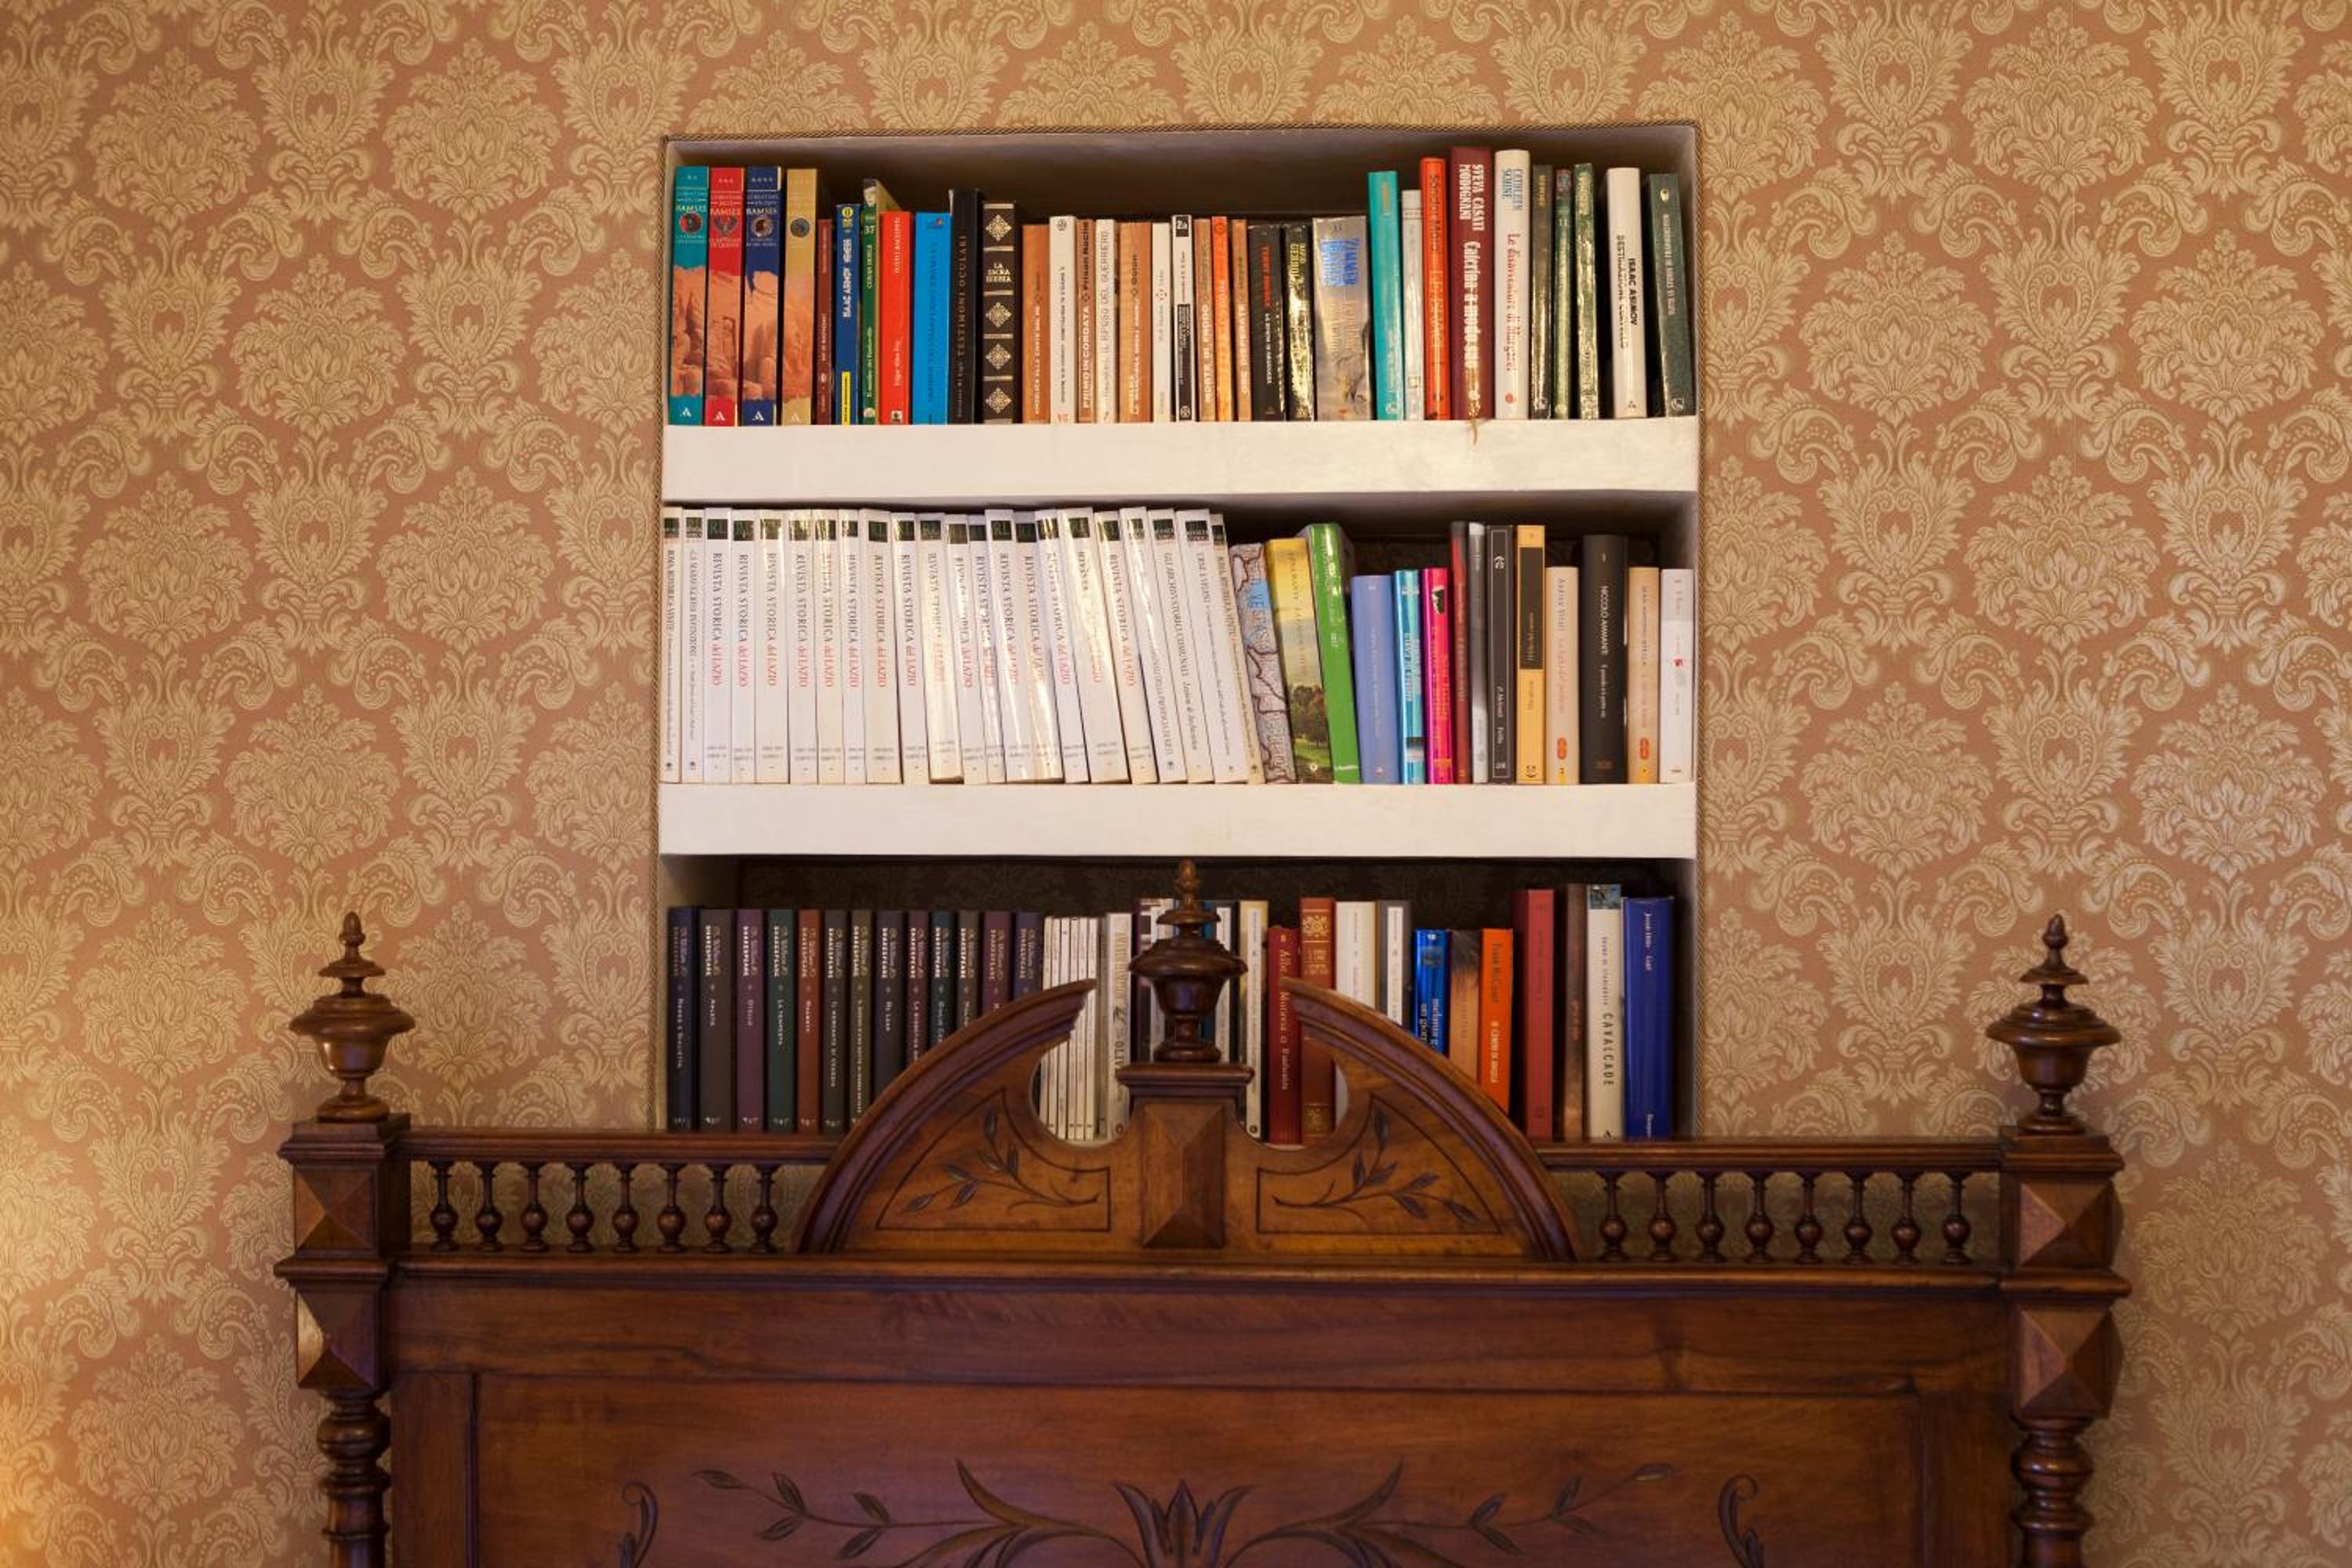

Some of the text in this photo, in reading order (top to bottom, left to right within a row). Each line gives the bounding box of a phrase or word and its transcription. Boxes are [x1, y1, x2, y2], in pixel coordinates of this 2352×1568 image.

[1460, 164, 1472, 220] MODIGNANI
[1472, 164, 1484, 231] SVEVA CASATI
[1464, 241, 1481, 288] Caterina
[1465, 305, 1480, 338] modo
[1629, 288, 1638, 325] ASIMOV
[713, 553, 722, 593] RIVISTA
[739, 554, 748, 594] RIVISTA
[767, 553, 776, 593] RIVISTA
[796, 554, 805, 593] RIVISTA
[874, 554, 884, 594] RIVISTA
[902, 554, 912, 593] RIVISTA
[975, 556, 987, 595] RIVISTA
[1025, 556, 1035, 595] RIVISTA
[713, 595, 722, 641] STORICA
[739, 596, 748, 642] STORICA
[767, 596, 776, 641] STORICA
[904, 595, 913, 642] STORICA
[1000, 553, 1015, 641] RIVISTA STORICA
[1109, 554, 1122, 594] RIVISTA
[1116, 598, 1129, 642] STORICA
[797, 598, 807, 642] STORICA
[823, 597, 833, 642] STORICA
[848, 597, 858, 643] STORICA
[876, 598, 885, 642] STORICA
[1029, 598, 1041, 641] STORICA
[1602, 1012, 1614, 1087] CAVALCADE
